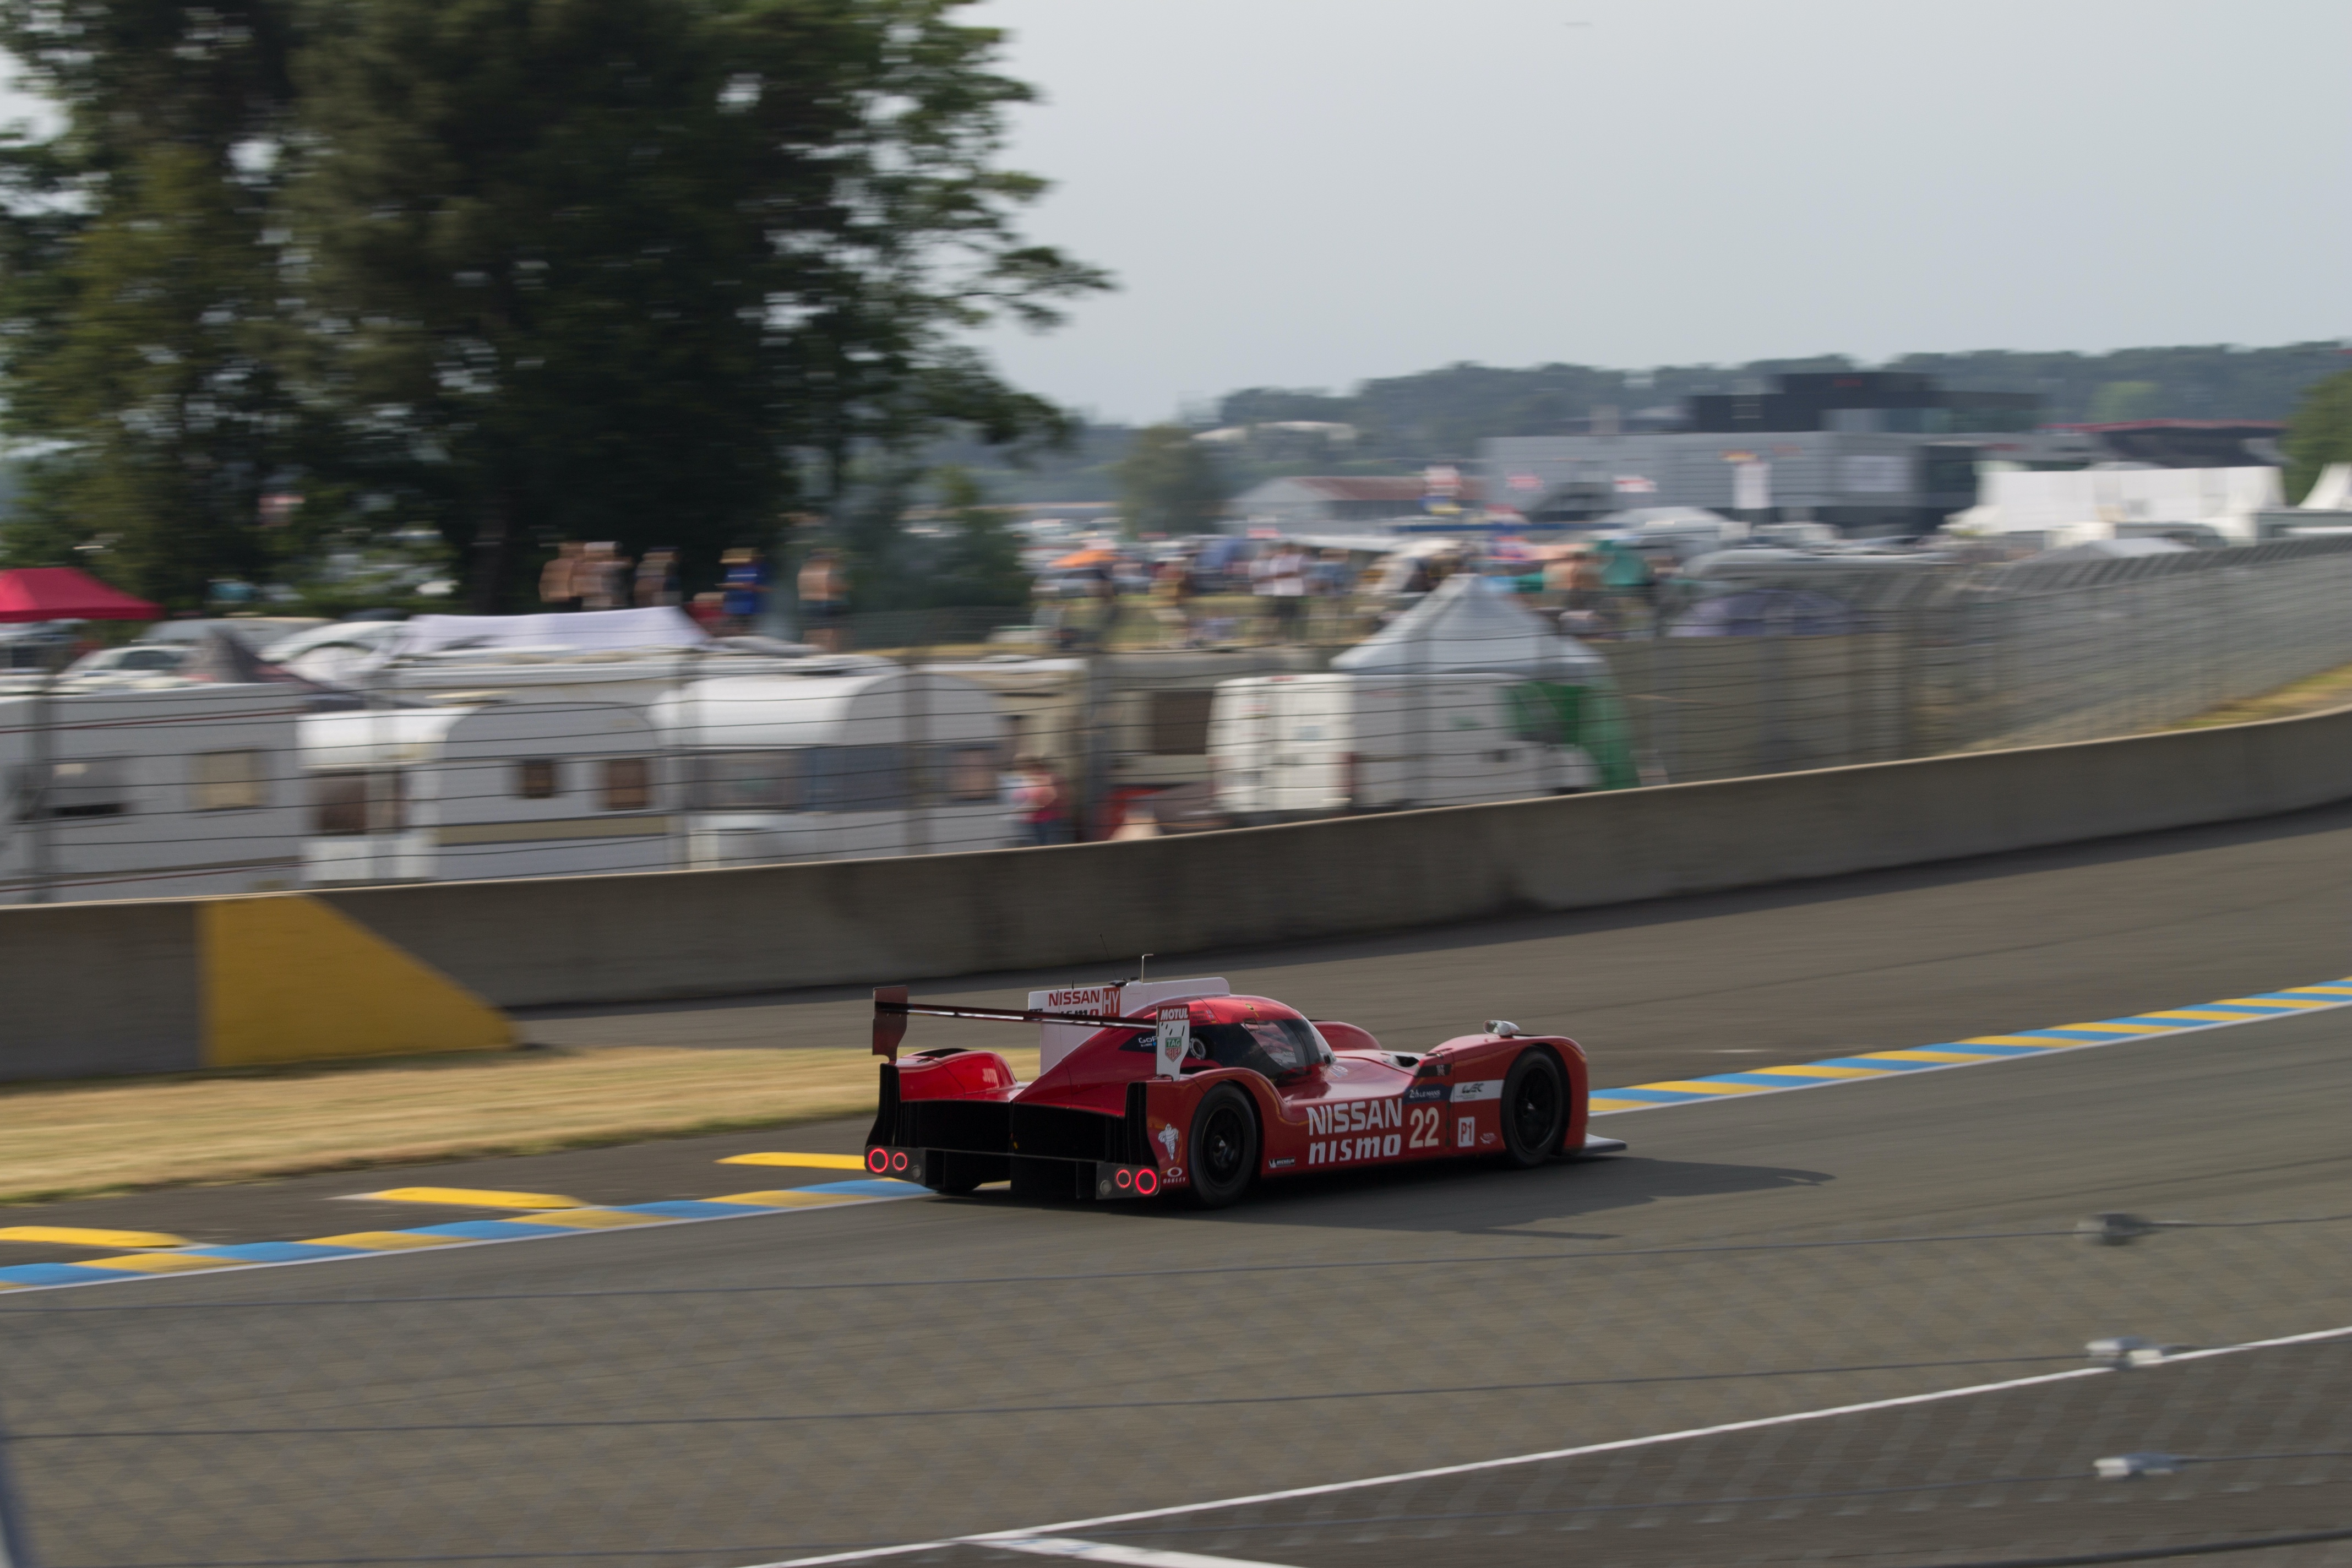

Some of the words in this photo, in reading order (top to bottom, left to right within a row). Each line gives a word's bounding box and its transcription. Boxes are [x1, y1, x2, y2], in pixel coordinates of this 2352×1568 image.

[1049, 990, 1100, 1006] NISSAN
[1103, 990, 1120, 1014] HY
[1160, 1008, 1189, 1020] MOTUL
[1167, 1039, 1180, 1047] TAG
[1166, 1048, 1181, 1060] HEUER
[1306, 1097, 1402, 1136] NISSAN
[1409, 1107, 1439, 1148] 22
[1461, 1121, 1472, 1142] P1
[1308, 1134, 1402, 1165] nismo
